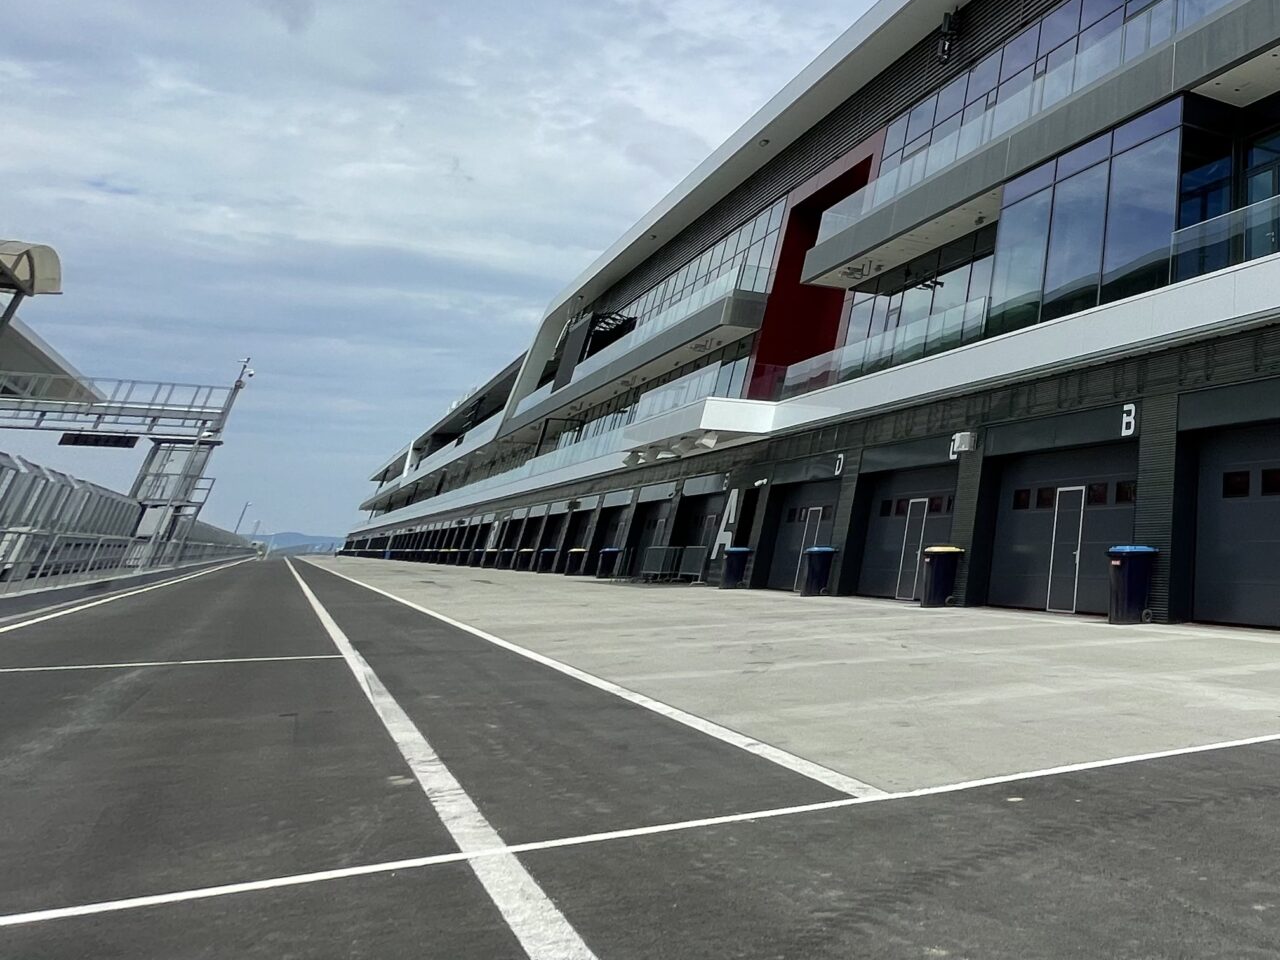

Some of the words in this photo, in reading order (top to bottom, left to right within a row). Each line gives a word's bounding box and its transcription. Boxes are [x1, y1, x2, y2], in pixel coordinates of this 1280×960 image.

[1121, 404, 1136, 436] B
[834, 453, 844, 476] D
[710, 488, 739, 560] A
